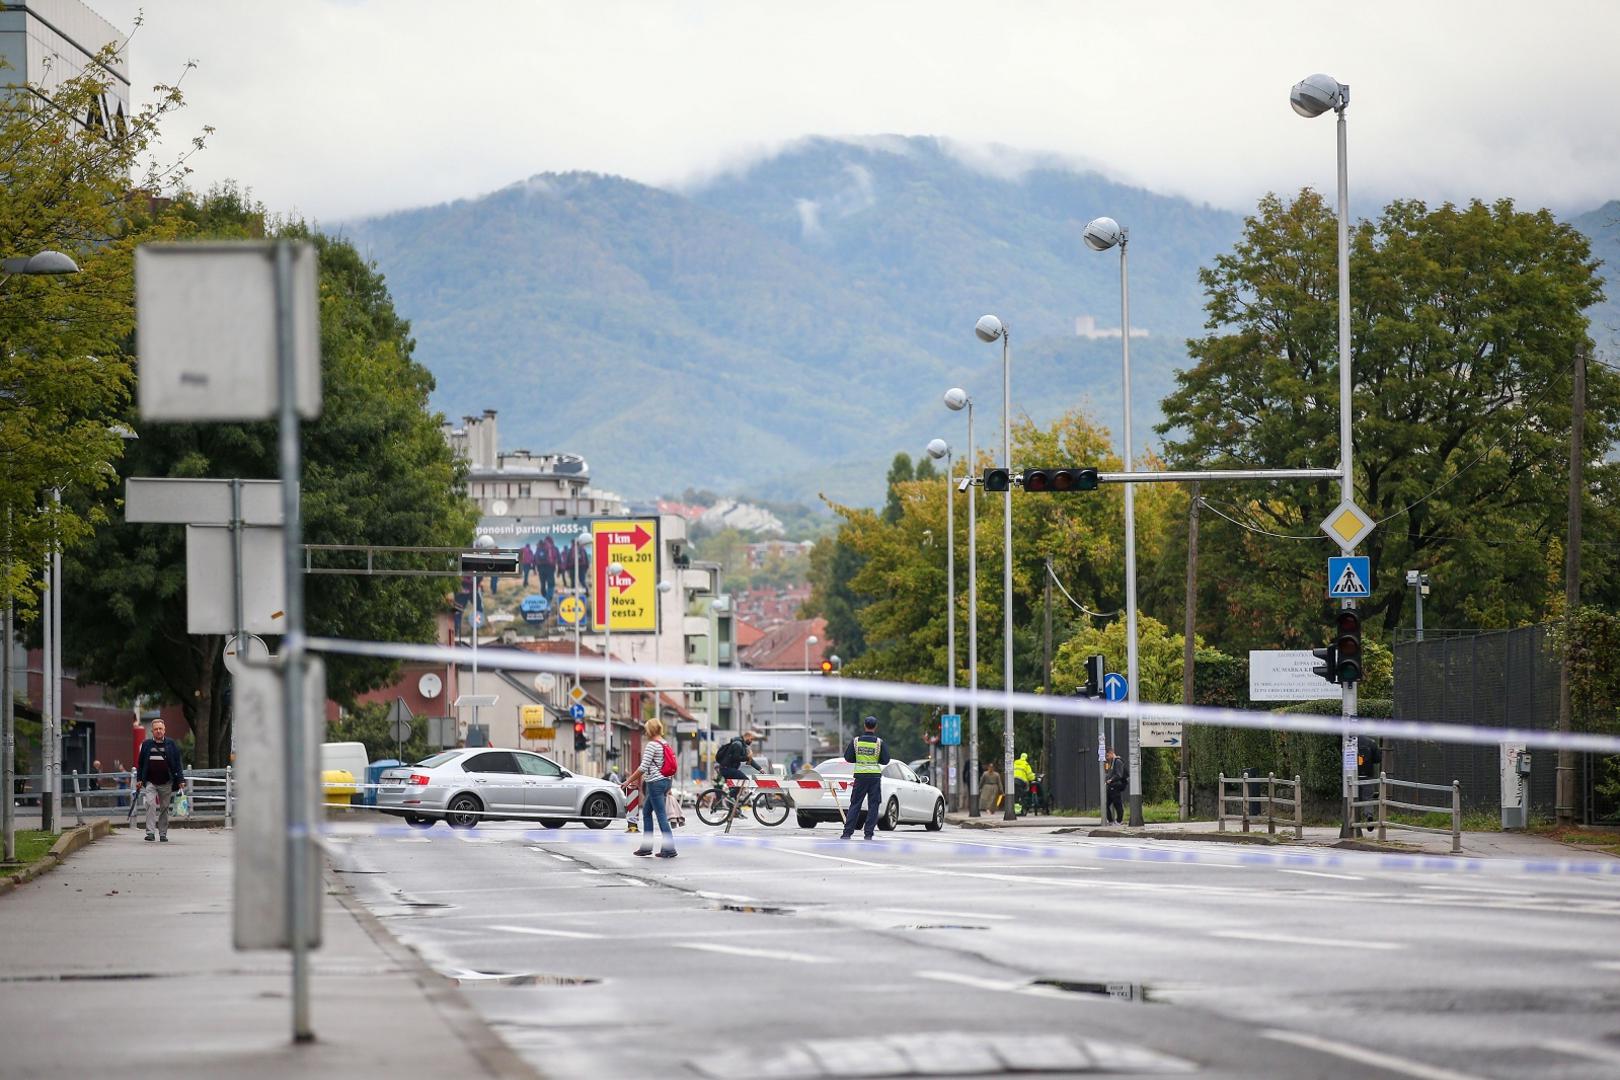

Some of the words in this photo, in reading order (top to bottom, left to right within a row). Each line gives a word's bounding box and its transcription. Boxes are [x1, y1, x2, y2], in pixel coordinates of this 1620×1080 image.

[476, 524, 514, 535] ponosni
[516, 525, 550, 535] partner
[552, 524, 588, 533] HGSS-a
[608, 534, 614, 543] 1
[614, 533, 631, 544] km
[612, 553, 633, 563] Ilica
[636, 553, 652, 563] 201
[609, 576, 614, 586] 1
[616, 576, 632, 586] km
[612, 597, 635, 606] Nova
[612, 608, 636, 617] cesta
[639, 608, 644, 617] 7
